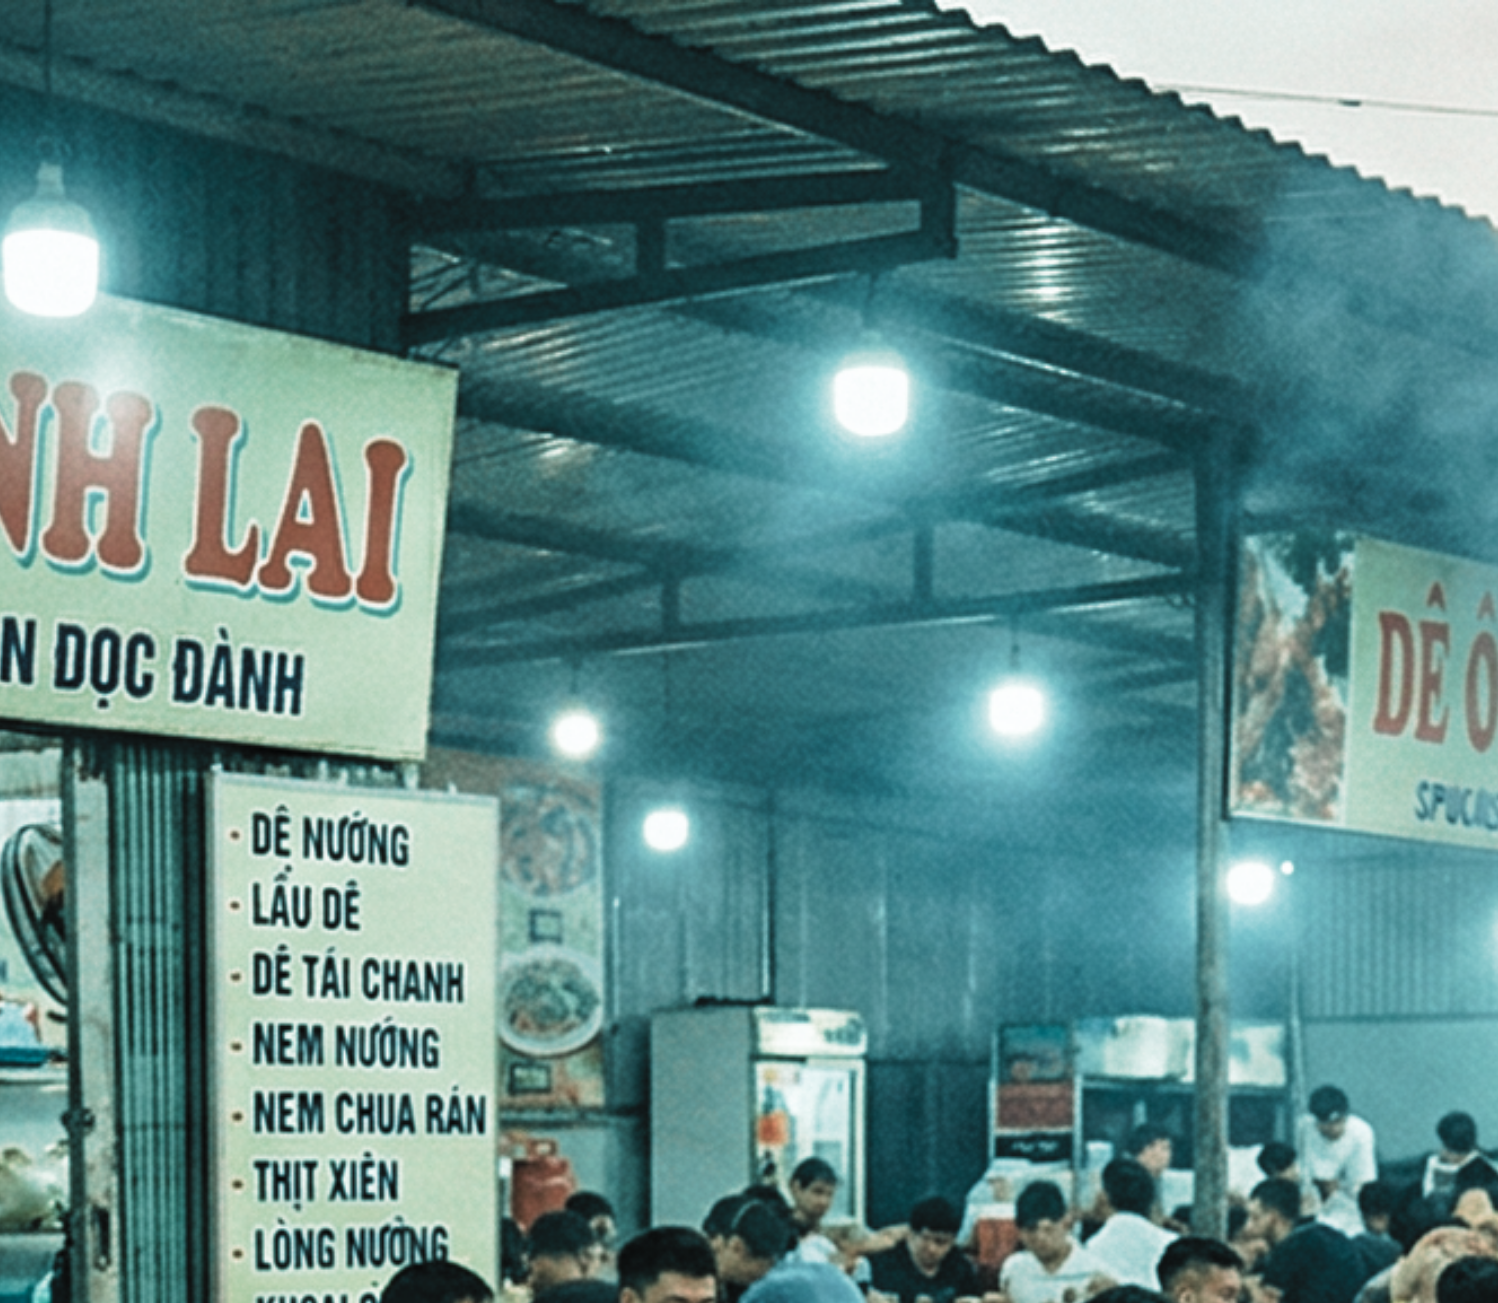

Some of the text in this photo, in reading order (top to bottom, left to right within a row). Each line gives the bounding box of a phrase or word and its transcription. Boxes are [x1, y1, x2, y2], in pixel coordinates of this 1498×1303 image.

[184, 405, 408, 606] LAI
[54, 623, 155, 708] DỌC
[173, 627, 304, 715] ĐÀNH
[1373, 581, 1449, 744] DÊ
[252, 804, 410, 866] DÊ NƯỚNG
[323, 880, 361, 930] DÊ
[253, 944, 464, 1003] DÊ TÁI CHANH
[253, 1016, 439, 1068] NEM NƯỚNG
[254, 1086, 486, 1134] NEM CHUA RÁN
[254, 1151, 398, 1212] THỊT XIÊN
[255, 1216, 448, 1270] LÒNG NƯỚNG
